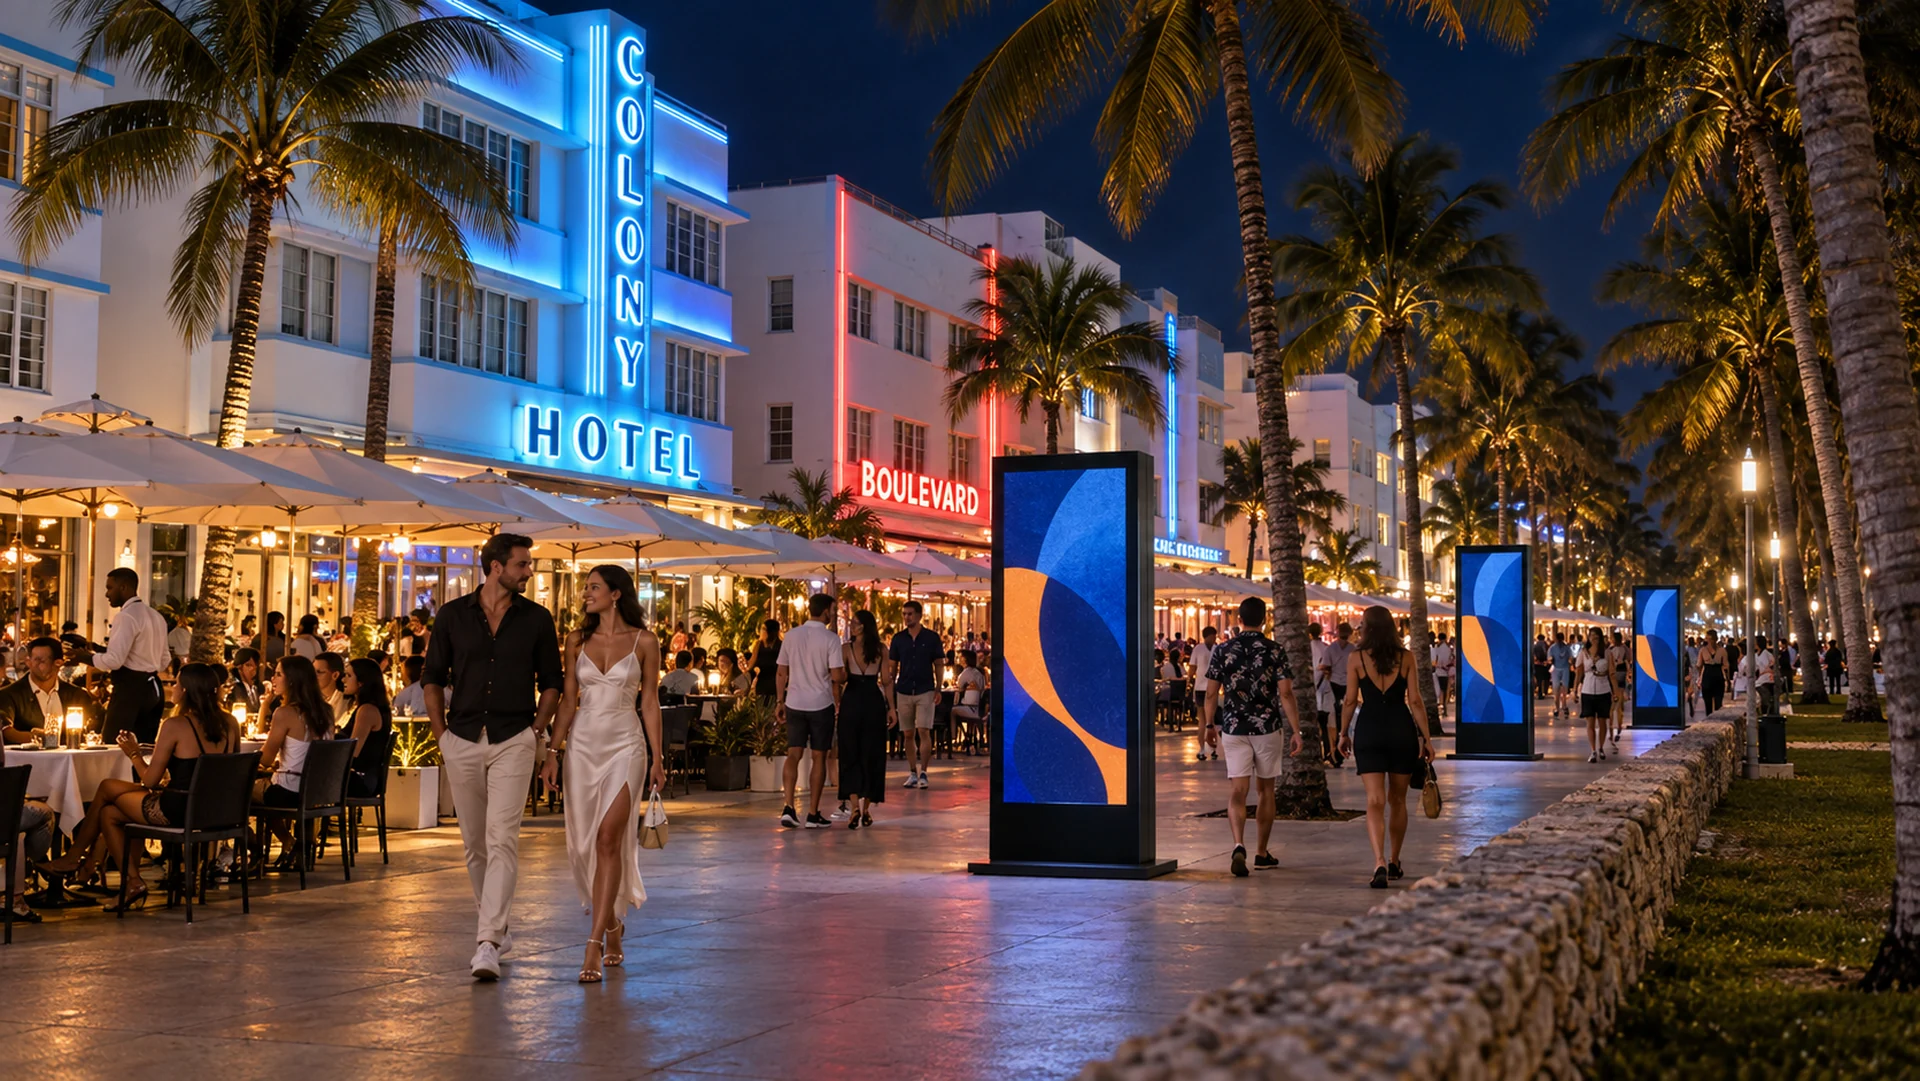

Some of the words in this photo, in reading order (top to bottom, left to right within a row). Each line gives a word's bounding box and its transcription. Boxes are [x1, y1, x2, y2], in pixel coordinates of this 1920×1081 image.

[615, 36, 645, 388] COLONY
[523, 403, 701, 481] HOTEL
[861, 459, 979, 516] BOULEVARD
